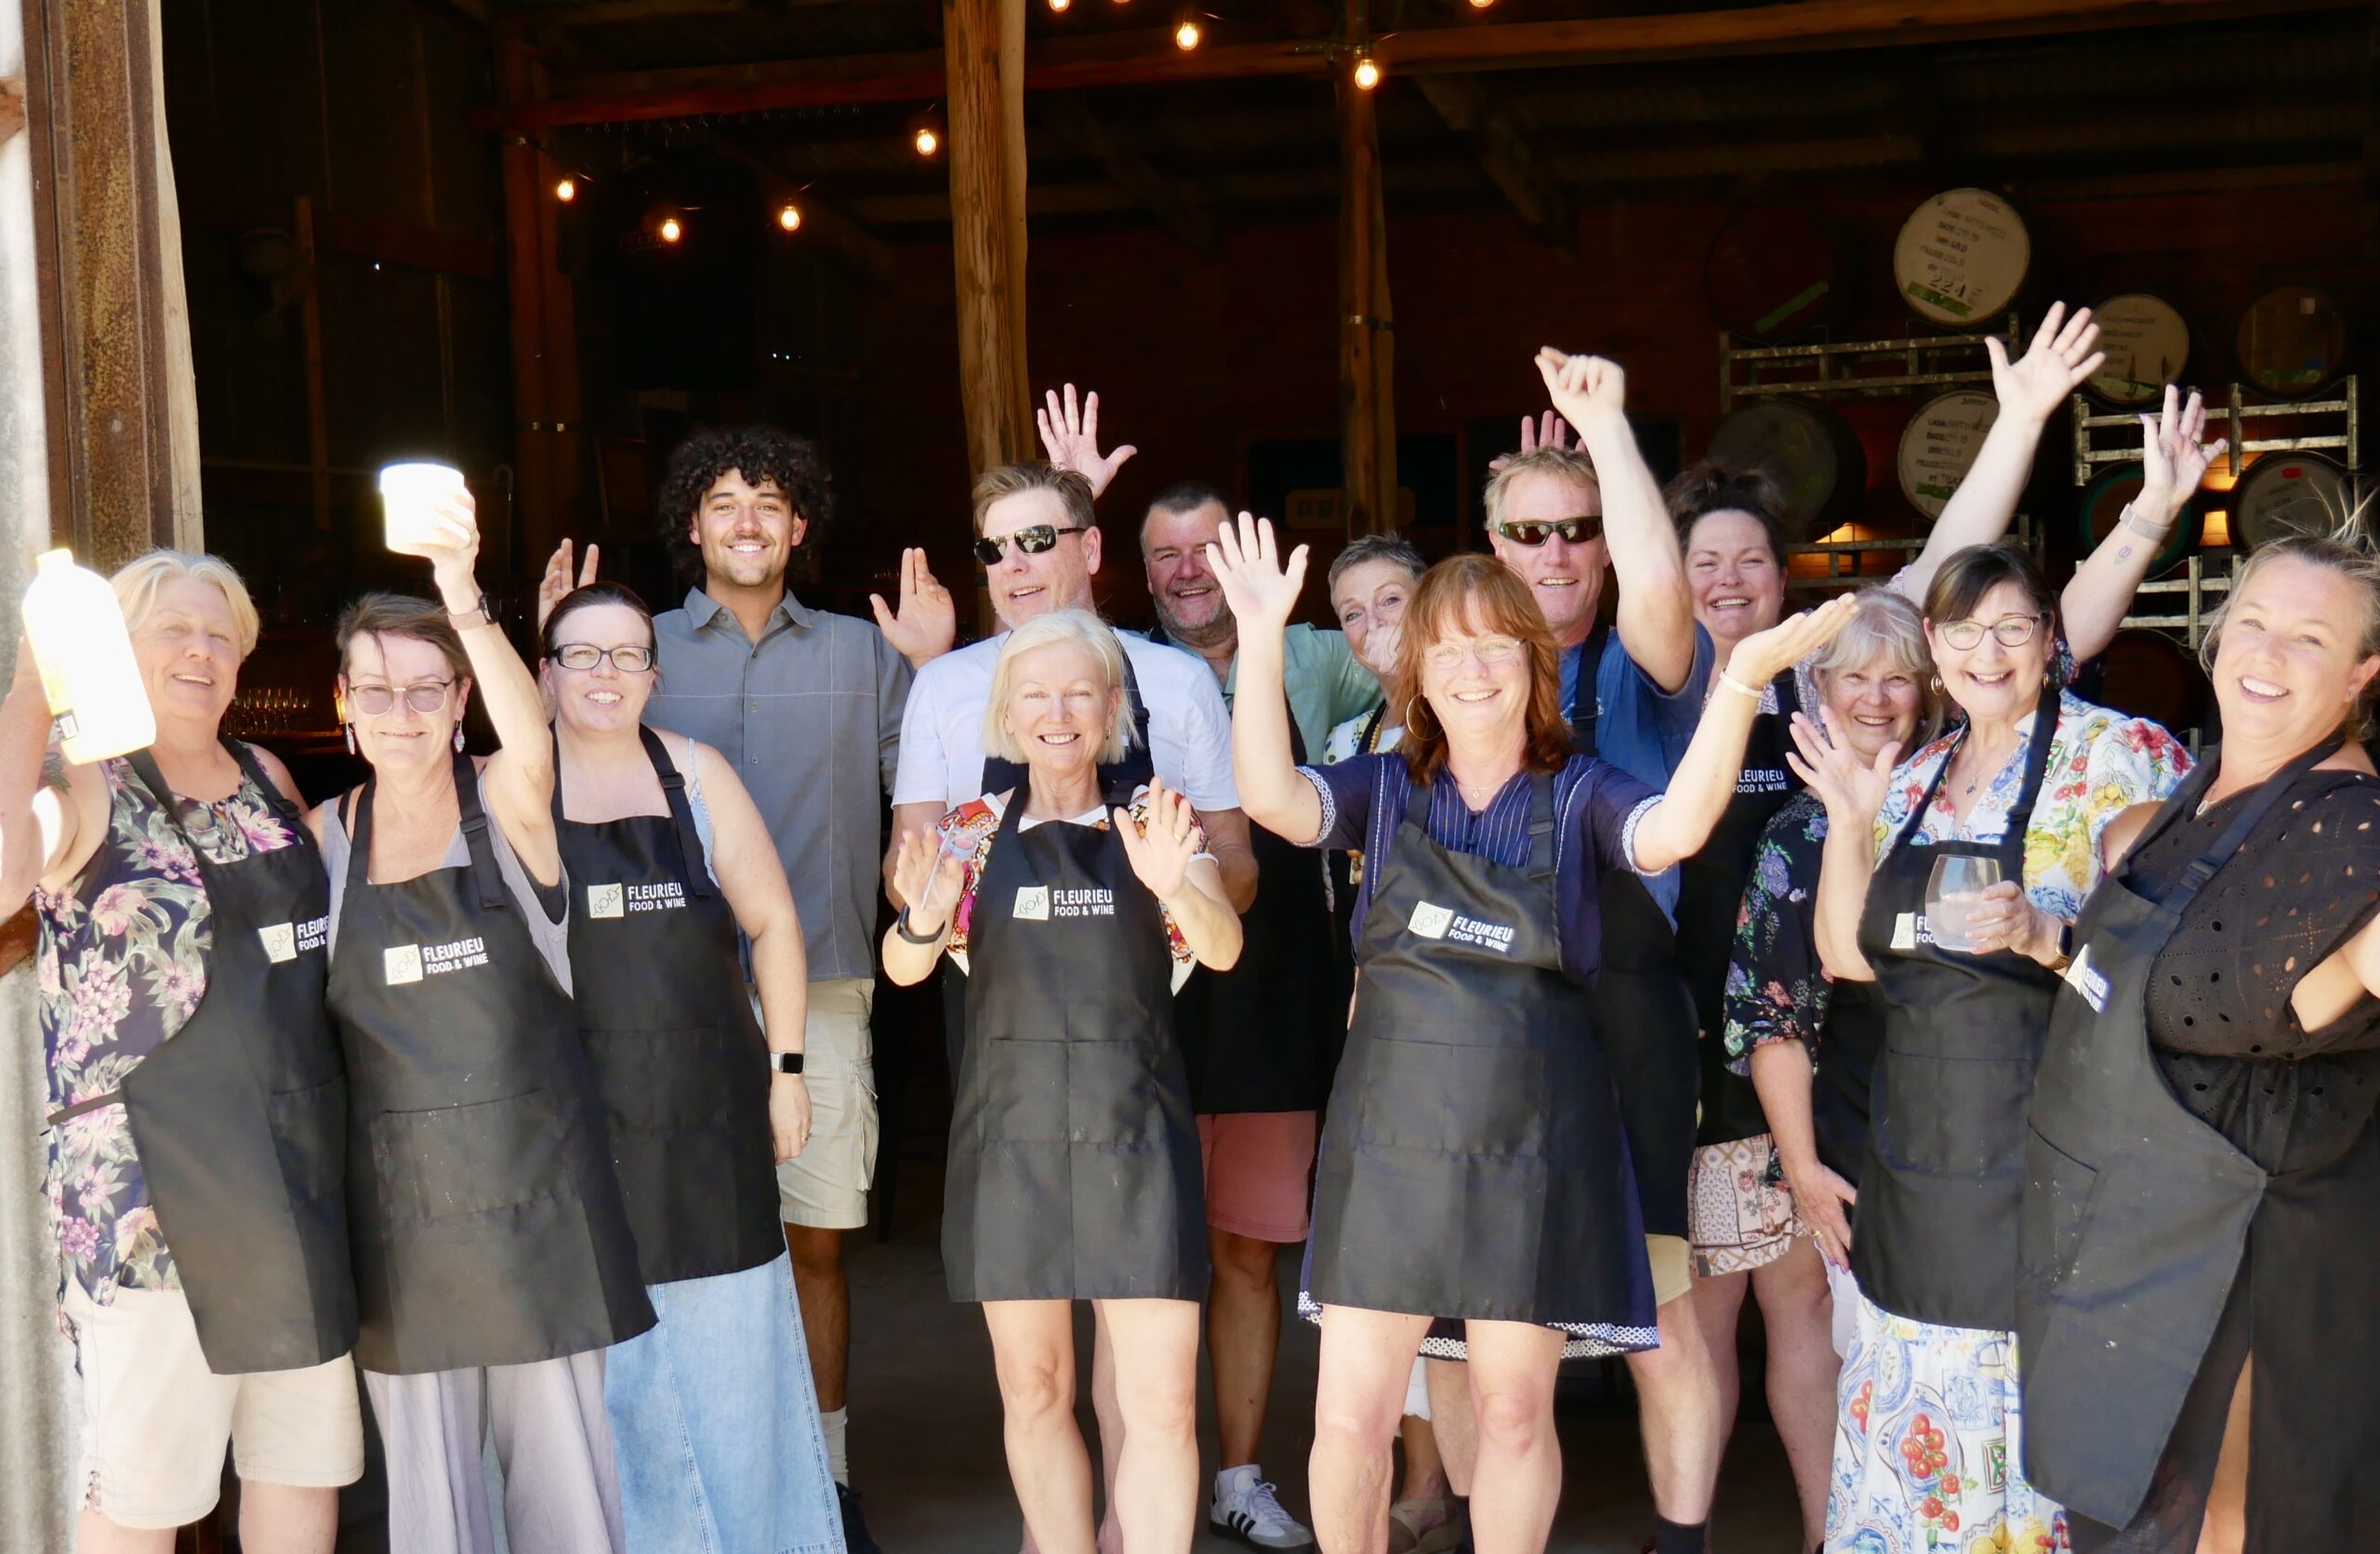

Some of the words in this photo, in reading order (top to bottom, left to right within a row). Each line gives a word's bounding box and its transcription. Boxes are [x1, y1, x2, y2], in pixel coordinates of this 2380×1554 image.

[1738, 769, 1784, 783] LEURIEU
[1758, 784, 1764, 793] &
[1766, 782, 1787, 792] WINE
[628, 882, 683, 901] FLEURIEU
[1053, 889, 1113, 905] FLEURIEU
[628, 900, 654, 912] FOOD
[655, 900, 663, 910] &
[665, 897, 687, 908] WINE
[1054, 905, 1080, 916] FOOD
[1082, 905, 1089, 915] &
[1091, 904, 1115, 915] WINE
[1452, 915, 1514, 942] FLEURIEU
[298, 936, 320, 952] FOOD
[320, 934, 326, 945] &
[1448, 928, 1474, 942] FOOD
[1474, 935, 1483, 945] &
[1485, 937, 1509, 952] WINE
[1915, 933, 1936, 943] FOO
[422, 936, 484, 963] FLEURIEU
[425, 961, 454, 974] FOOD
[454, 959, 463, 969] &
[463, 953, 489, 968] WINE
